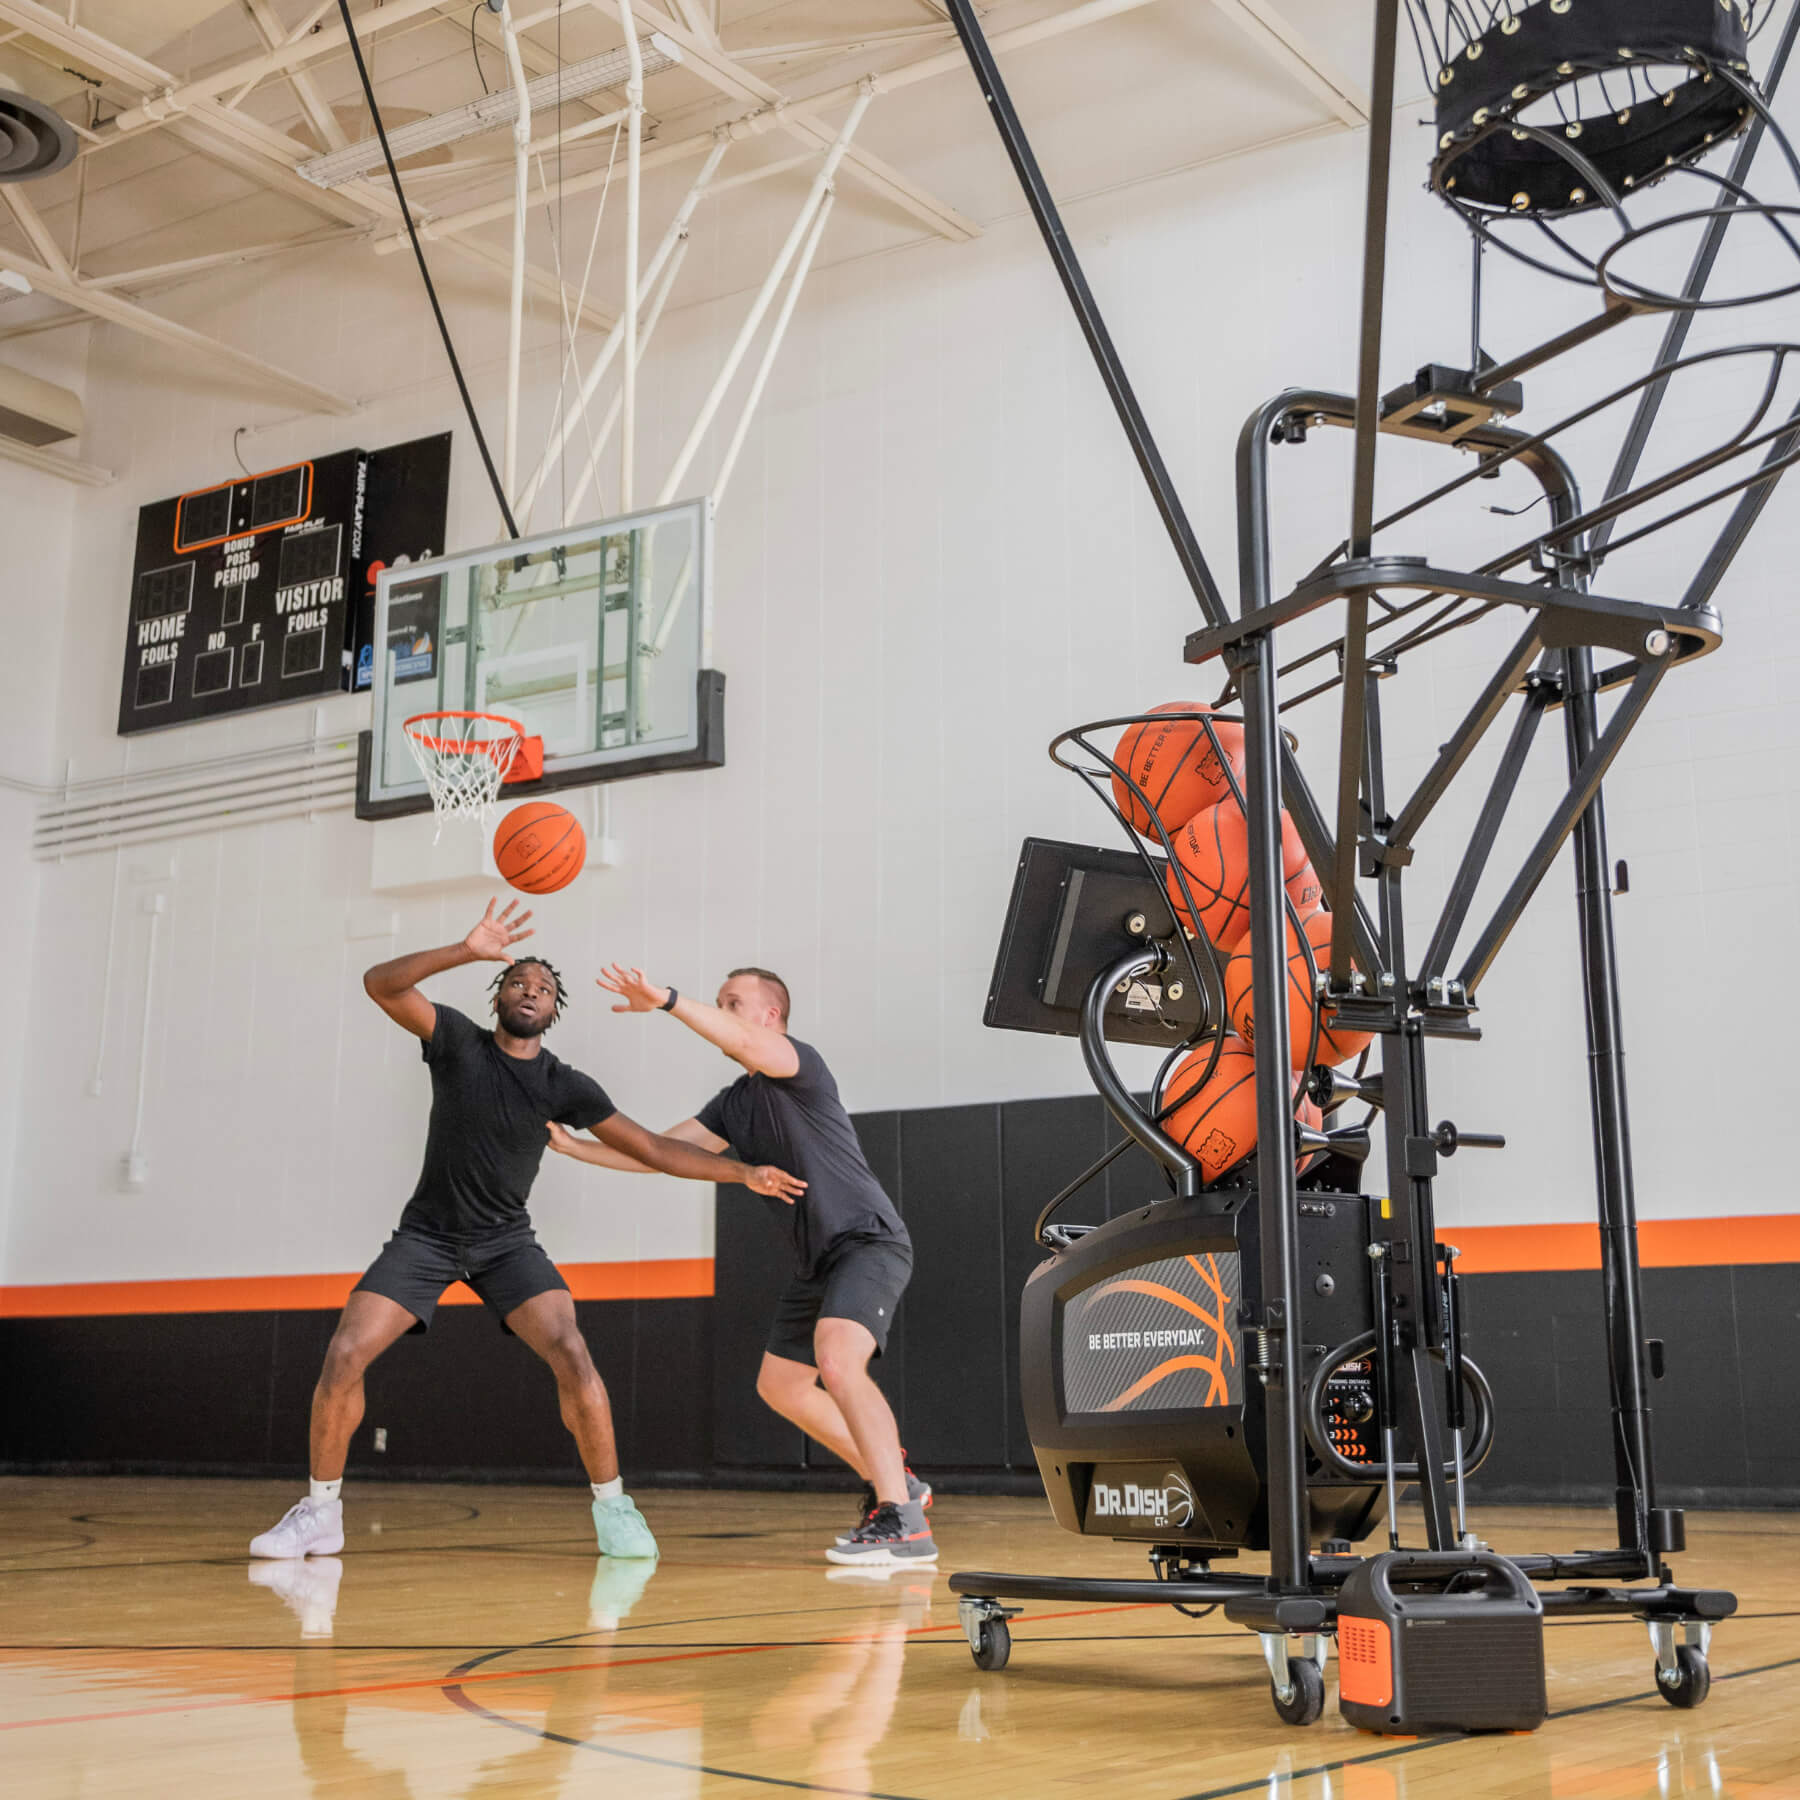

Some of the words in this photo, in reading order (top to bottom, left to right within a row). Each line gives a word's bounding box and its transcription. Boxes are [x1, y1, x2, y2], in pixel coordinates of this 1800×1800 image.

[223, 535, 256, 555] BONUS
[226, 549, 251, 568] POSS
[214, 561, 260, 589] PERIOD
[275, 577, 344, 615] VISITOR
[138, 614, 186, 646] HOME
[287, 607, 329, 634] FOULS
[208, 631, 226, 650] NO
[251, 623, 261, 641] F
[140, 642, 179, 667] FOULS
[1143, 734, 1166, 773] BETTER
[1139, 772, 1150, 788] BE
[1088, 1334, 1102, 1350] BE
[1103, 1332, 1141, 1350] BETTER
[1328, 1415, 1335, 1423] 2
[1329, 1431, 1336, 1439] 3
